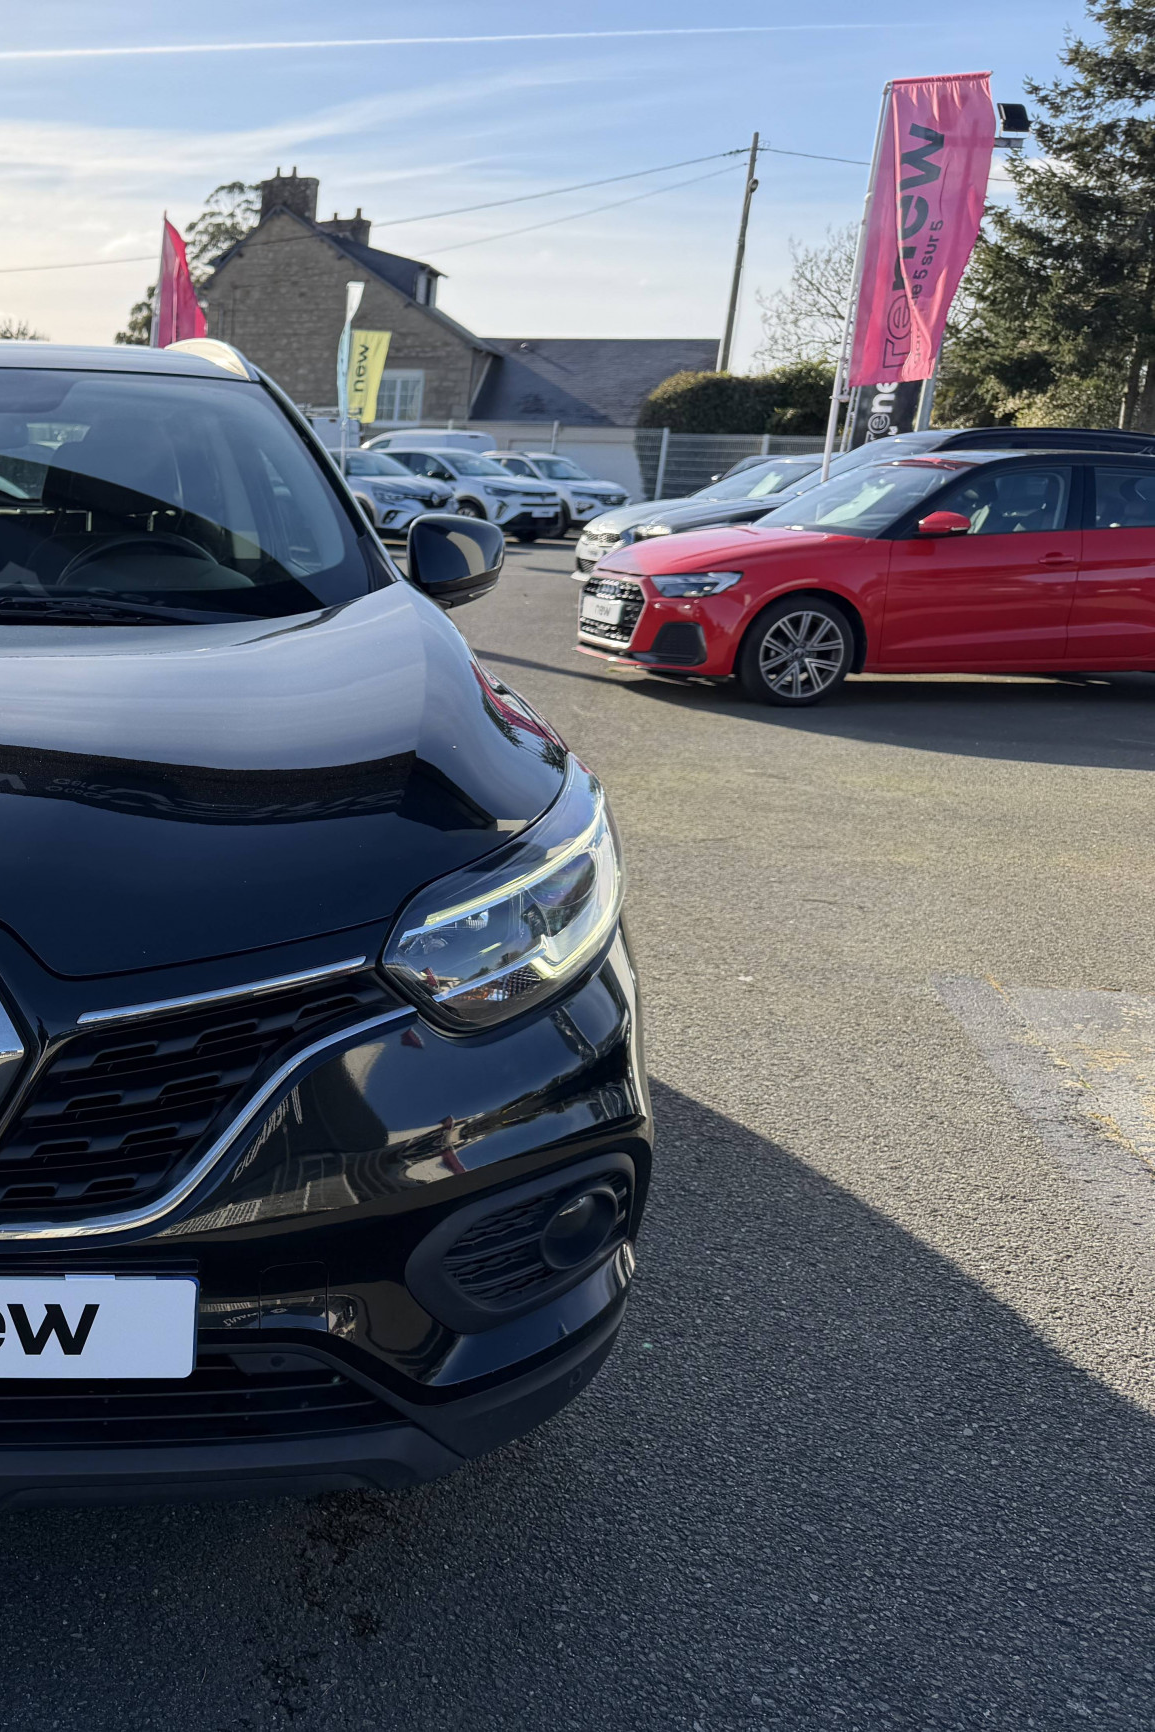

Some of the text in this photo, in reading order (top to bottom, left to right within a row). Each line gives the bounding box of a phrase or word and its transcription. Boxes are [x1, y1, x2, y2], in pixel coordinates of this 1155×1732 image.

[929, 219, 944, 231] 5
[921, 236, 940, 266] sur
[913, 269, 928, 279] 5
